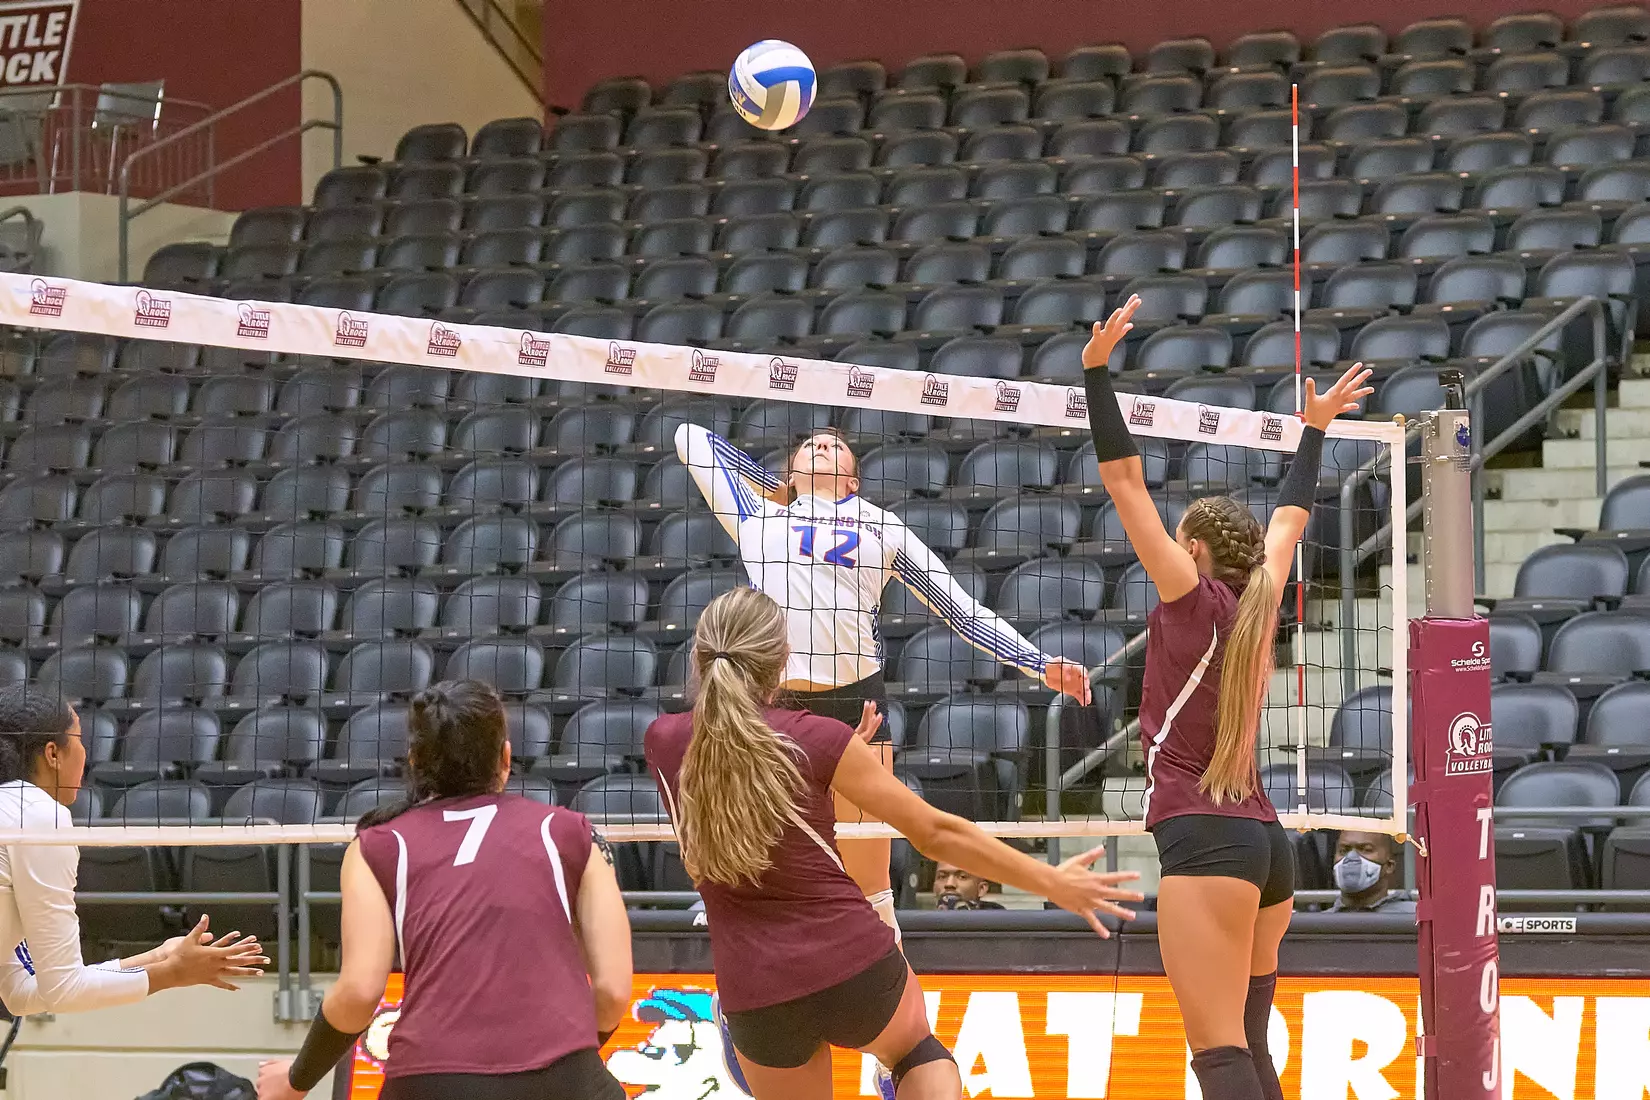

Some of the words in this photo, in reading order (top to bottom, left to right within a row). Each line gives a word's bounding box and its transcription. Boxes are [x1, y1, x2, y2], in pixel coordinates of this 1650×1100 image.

[0, 51, 60, 84] CK
[149, 309, 170, 318] ROCK
[250, 319, 269, 328] ROCK
[349, 329, 367, 338] ROCK
[441, 339, 461, 348] ROCK
[530, 349, 548, 358] ROCK
[932, 390, 948, 398] ROCK
[1267, 425, 1282, 433] ROCK
[791, 525, 861, 570] 12
[443, 804, 498, 866] 7
[692, 911, 709, 926] A
[1497, 918, 1523, 933] CE
[1526, 920, 1573, 930] SPORTS
[861, 991, 1144, 1099] AT
